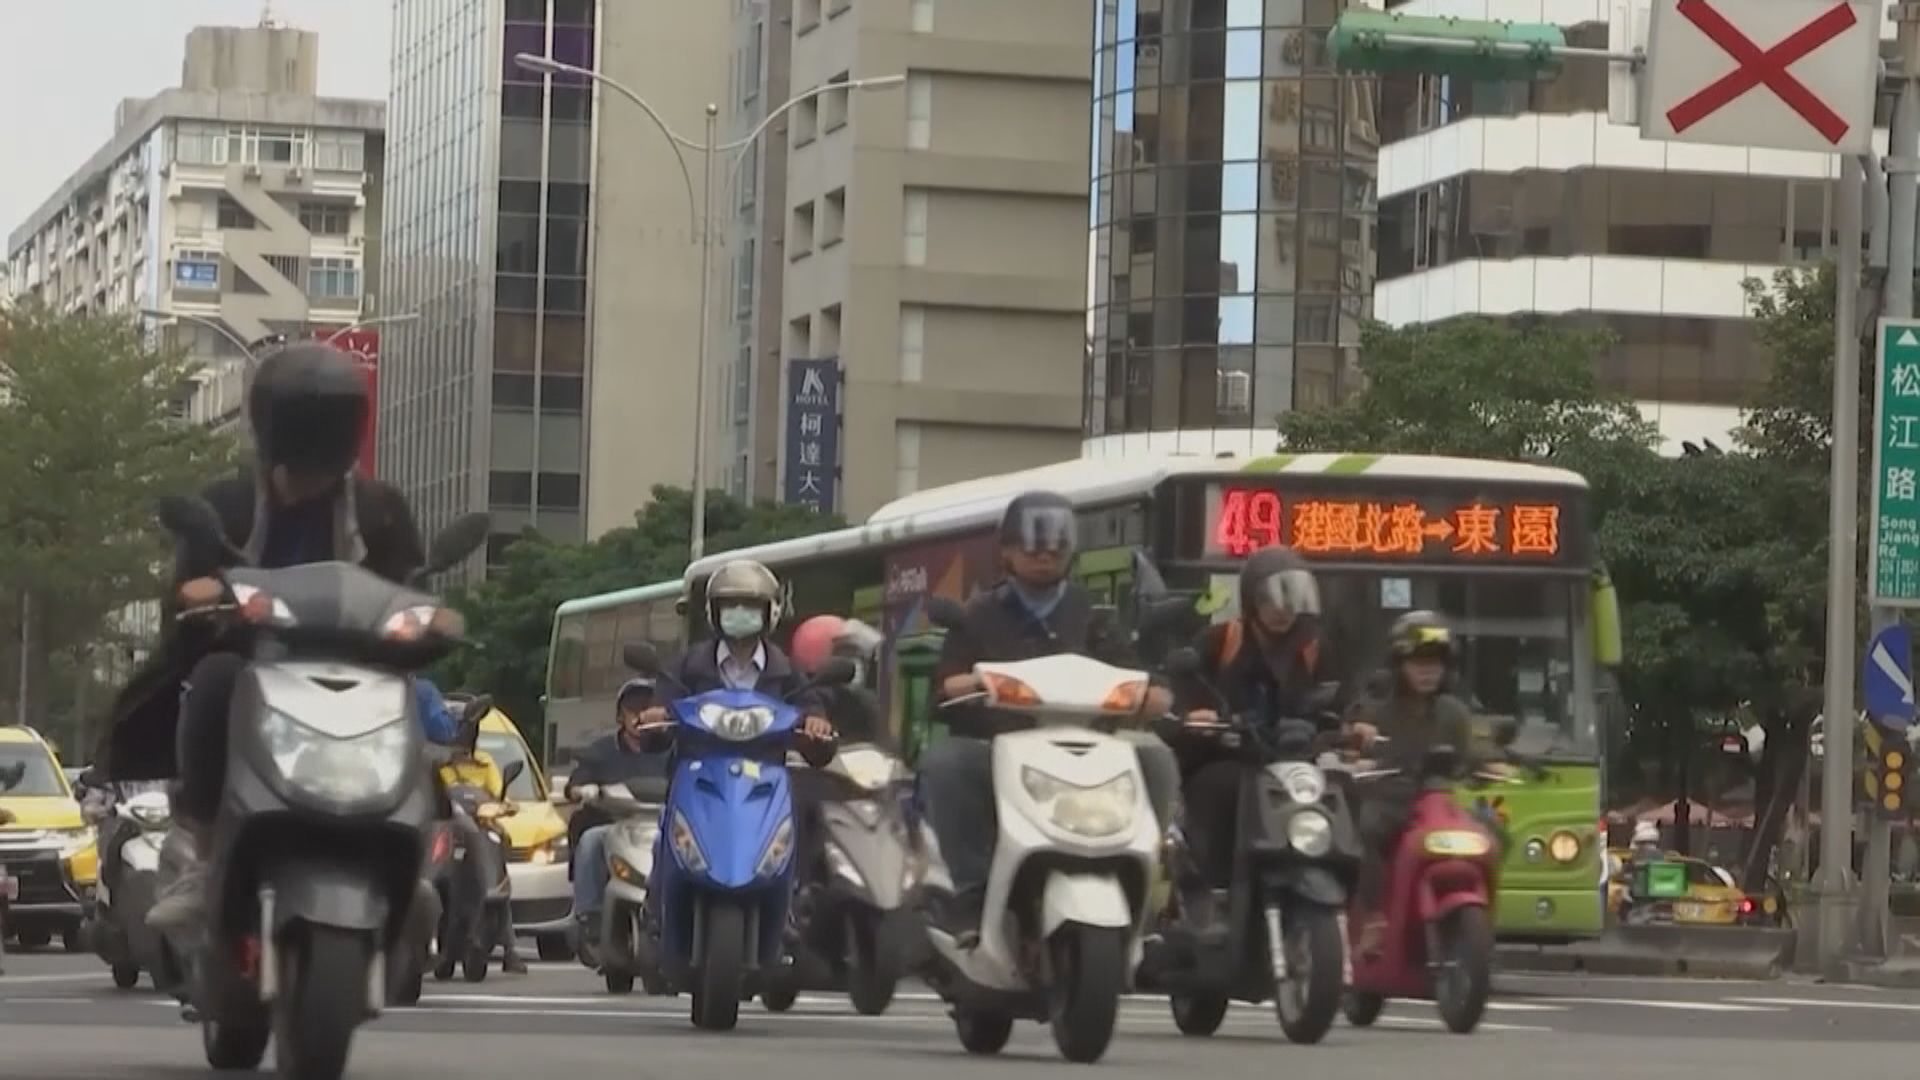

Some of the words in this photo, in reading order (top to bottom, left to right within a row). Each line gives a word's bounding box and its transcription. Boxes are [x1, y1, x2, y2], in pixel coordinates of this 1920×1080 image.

[795, 394, 829, 406] HOTEL
[1886, 362, 1920, 501] 松江路
[1217, 489, 1281, 554] 49
[1293, 501, 1424, 551] 建國北路
[1453, 503, 1558, 553] 東園
[1880, 515, 1917, 532] Song
[1880, 530, 1920, 548] Jiang
